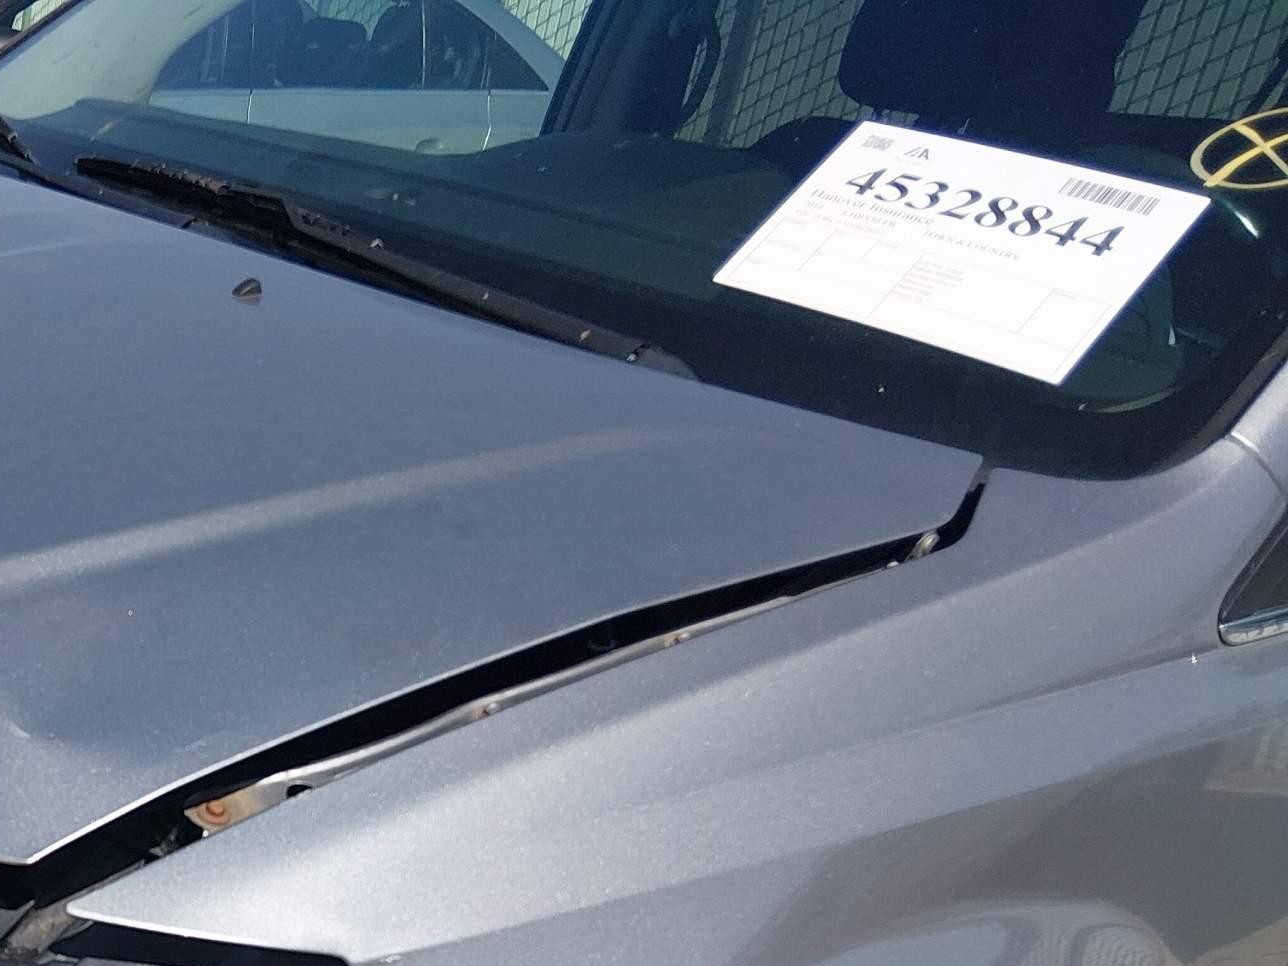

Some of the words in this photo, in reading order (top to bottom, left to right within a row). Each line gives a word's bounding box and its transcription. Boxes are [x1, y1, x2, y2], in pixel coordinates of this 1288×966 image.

[811, 188, 866, 208] Hanover
[869, 203, 935, 225] Insurance
[845, 168, 1125, 257] 45328844
